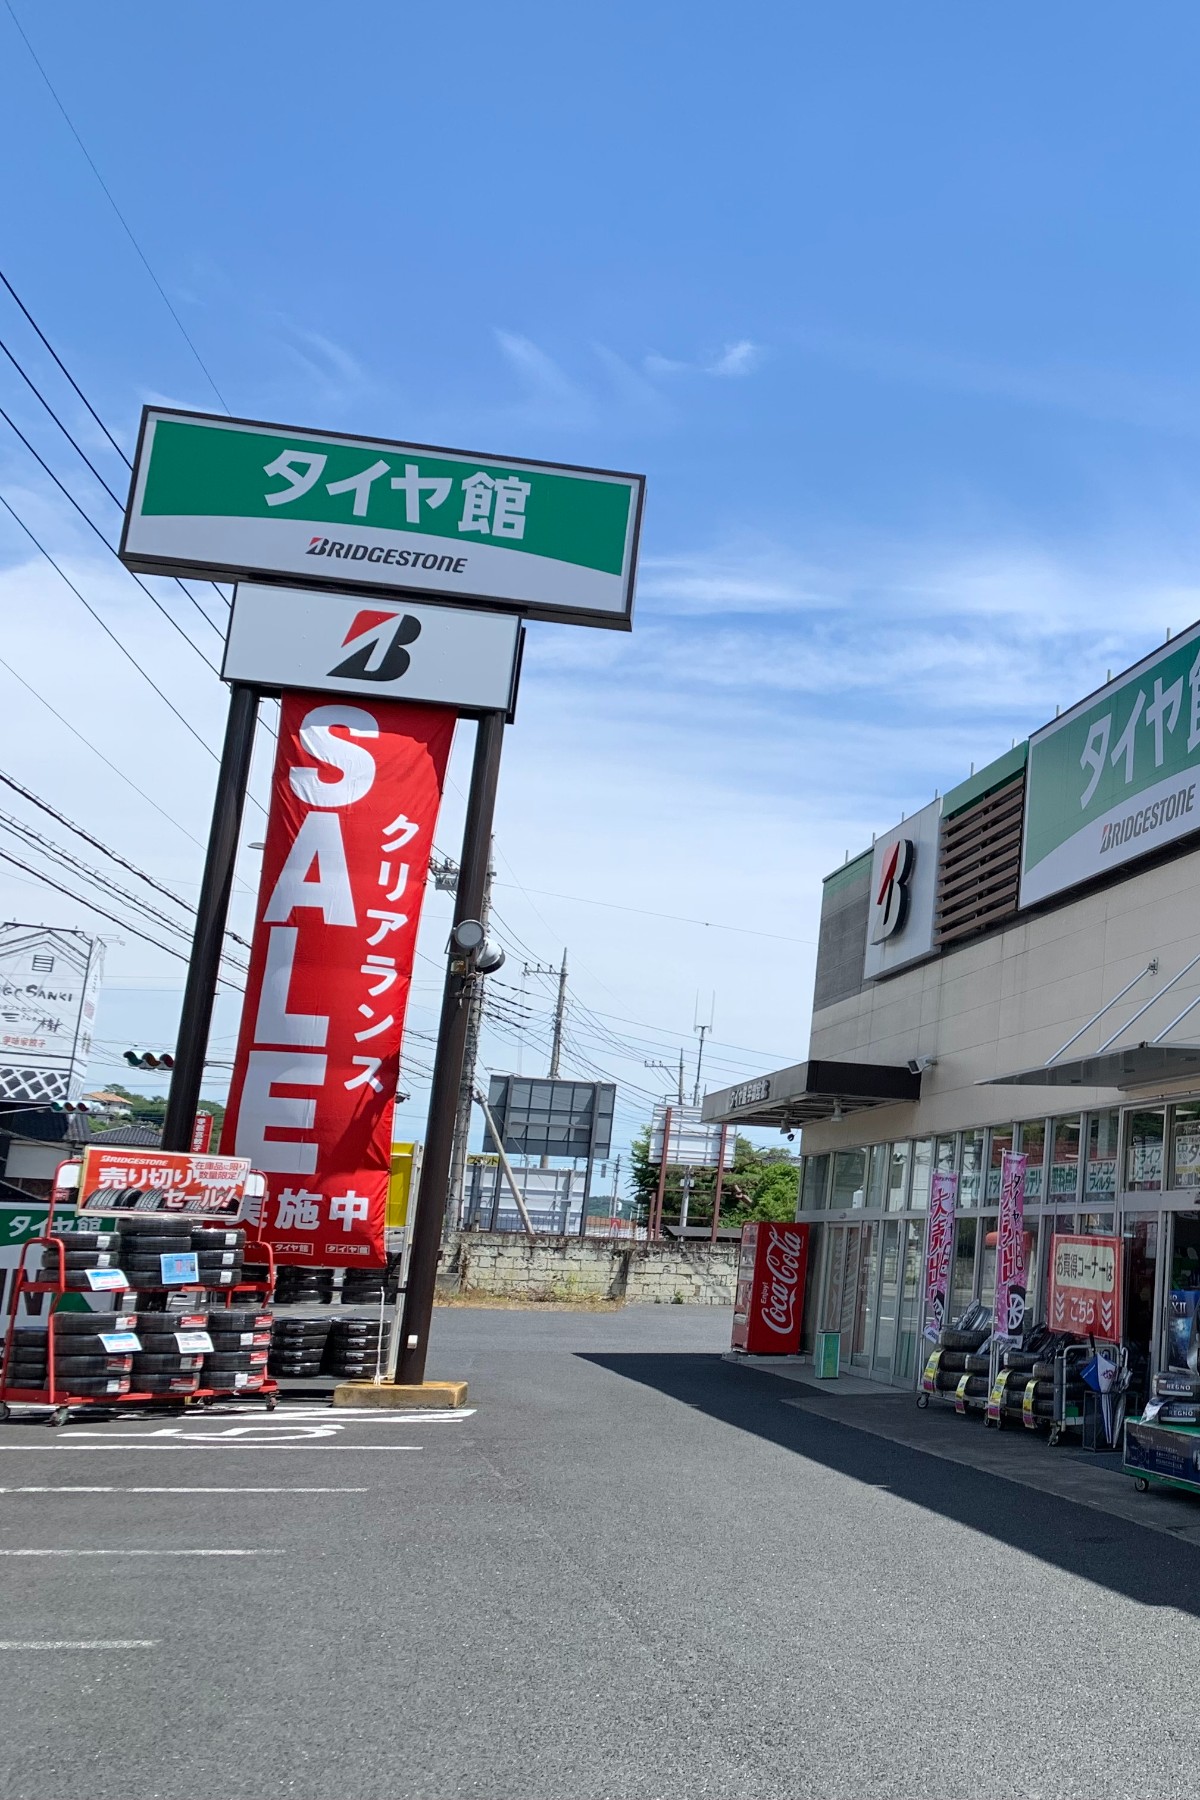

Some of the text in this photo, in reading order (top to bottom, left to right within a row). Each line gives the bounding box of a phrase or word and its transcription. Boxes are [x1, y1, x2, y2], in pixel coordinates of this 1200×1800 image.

[263, 449, 531, 541] タイヤ館
[305, 537, 469, 574] BRIDGESTONE
[1100, 784, 1197, 854] BRIDGESTONE
[235, 704, 380, 1175] SALE
[343, 813, 420, 1093] クリアランス
[100, 1154, 168, 1167] BRIDGESTONE
[194, 1161, 248, 1171] 在庫品に限り
[98, 1166, 193, 1190] 売り切り
[163, 1187, 237, 1208] セール!
[9, 1215, 103, 1238] タイヤ館
[761, 1224, 801, 1335] Coca-Cola
[1056, 1253, 1113, 1282] お買得コーナーは
[761, 1281, 769, 1305] Enjoy!
[1070, 1296, 1095, 1325] こちら
[1169, 1409, 1194, 1417] REGNO
